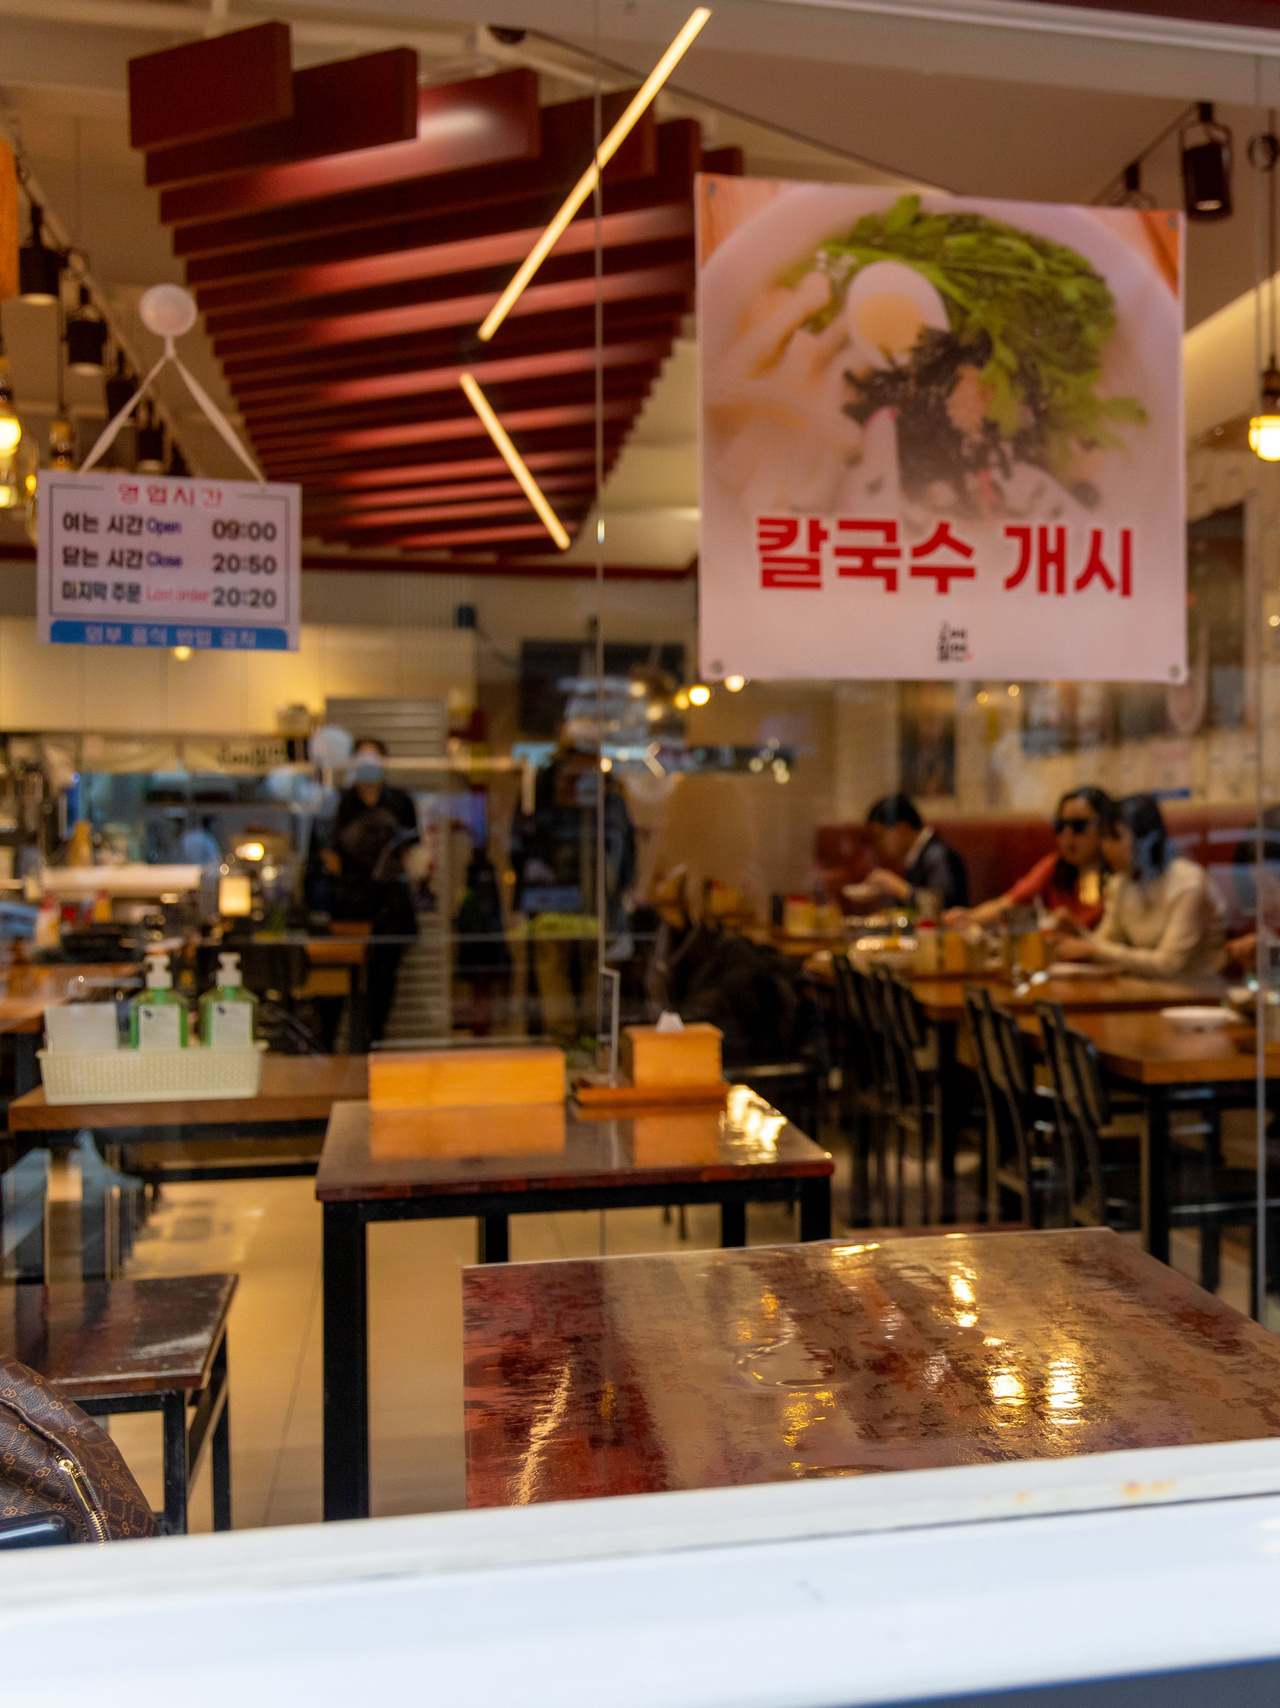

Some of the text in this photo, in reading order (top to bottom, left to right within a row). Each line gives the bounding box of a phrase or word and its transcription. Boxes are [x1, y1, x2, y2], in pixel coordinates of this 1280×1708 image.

[107, 514, 143, 536] 시간
[146, 517, 182, 536] Open
[212, 519, 277, 541] 09:00
[107, 548, 143, 570] 시간
[146, 550, 182, 568] Close
[212, 552, 277, 575] 20:50
[757, 518, 1133, 597] 칼국수 개시
[212, 586, 277, 608] 20:20
